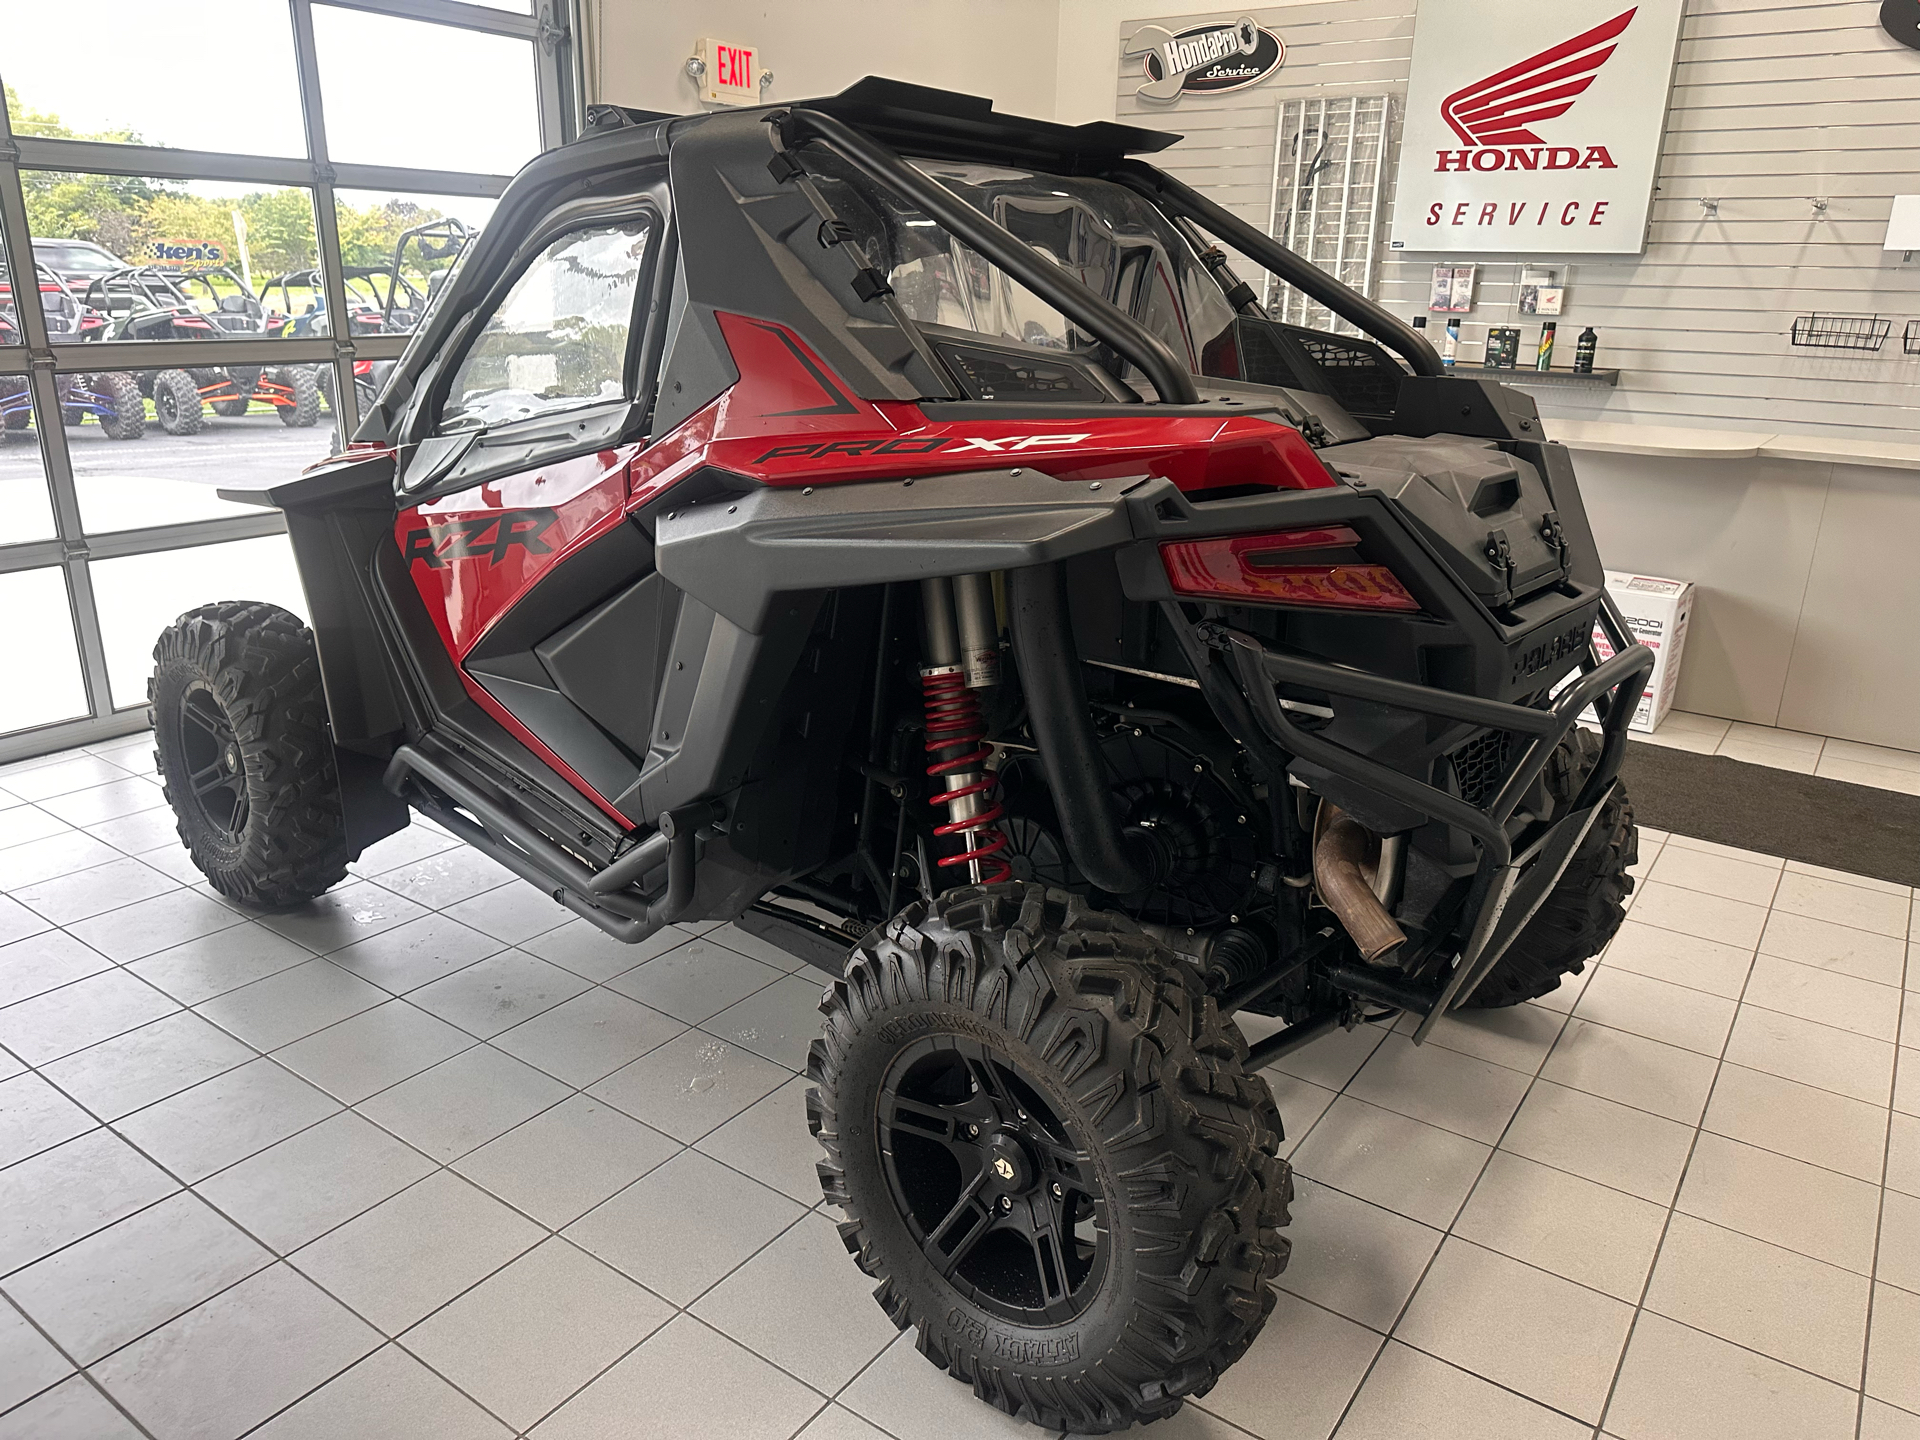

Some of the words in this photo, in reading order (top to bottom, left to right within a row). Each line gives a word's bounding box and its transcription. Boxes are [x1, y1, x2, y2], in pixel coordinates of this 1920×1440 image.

[717, 45, 752, 89] EXIT
[1163, 31, 1239, 76] HondaPro
[1206, 63, 1261, 78] Service
[1433, 146, 1618, 172] HONDA
[1426, 201, 1610, 227] SERVICE
[180, 255, 225, 273] Sports
[751, 438, 952, 464] PRO
[940, 433, 1093, 453] XP
[404, 507, 560, 570] RZR
[1623, 616, 1663, 628] 200i
[1512, 621, 1587, 685] POLARIS
[994, 1321, 1080, 1367] ATTACK
